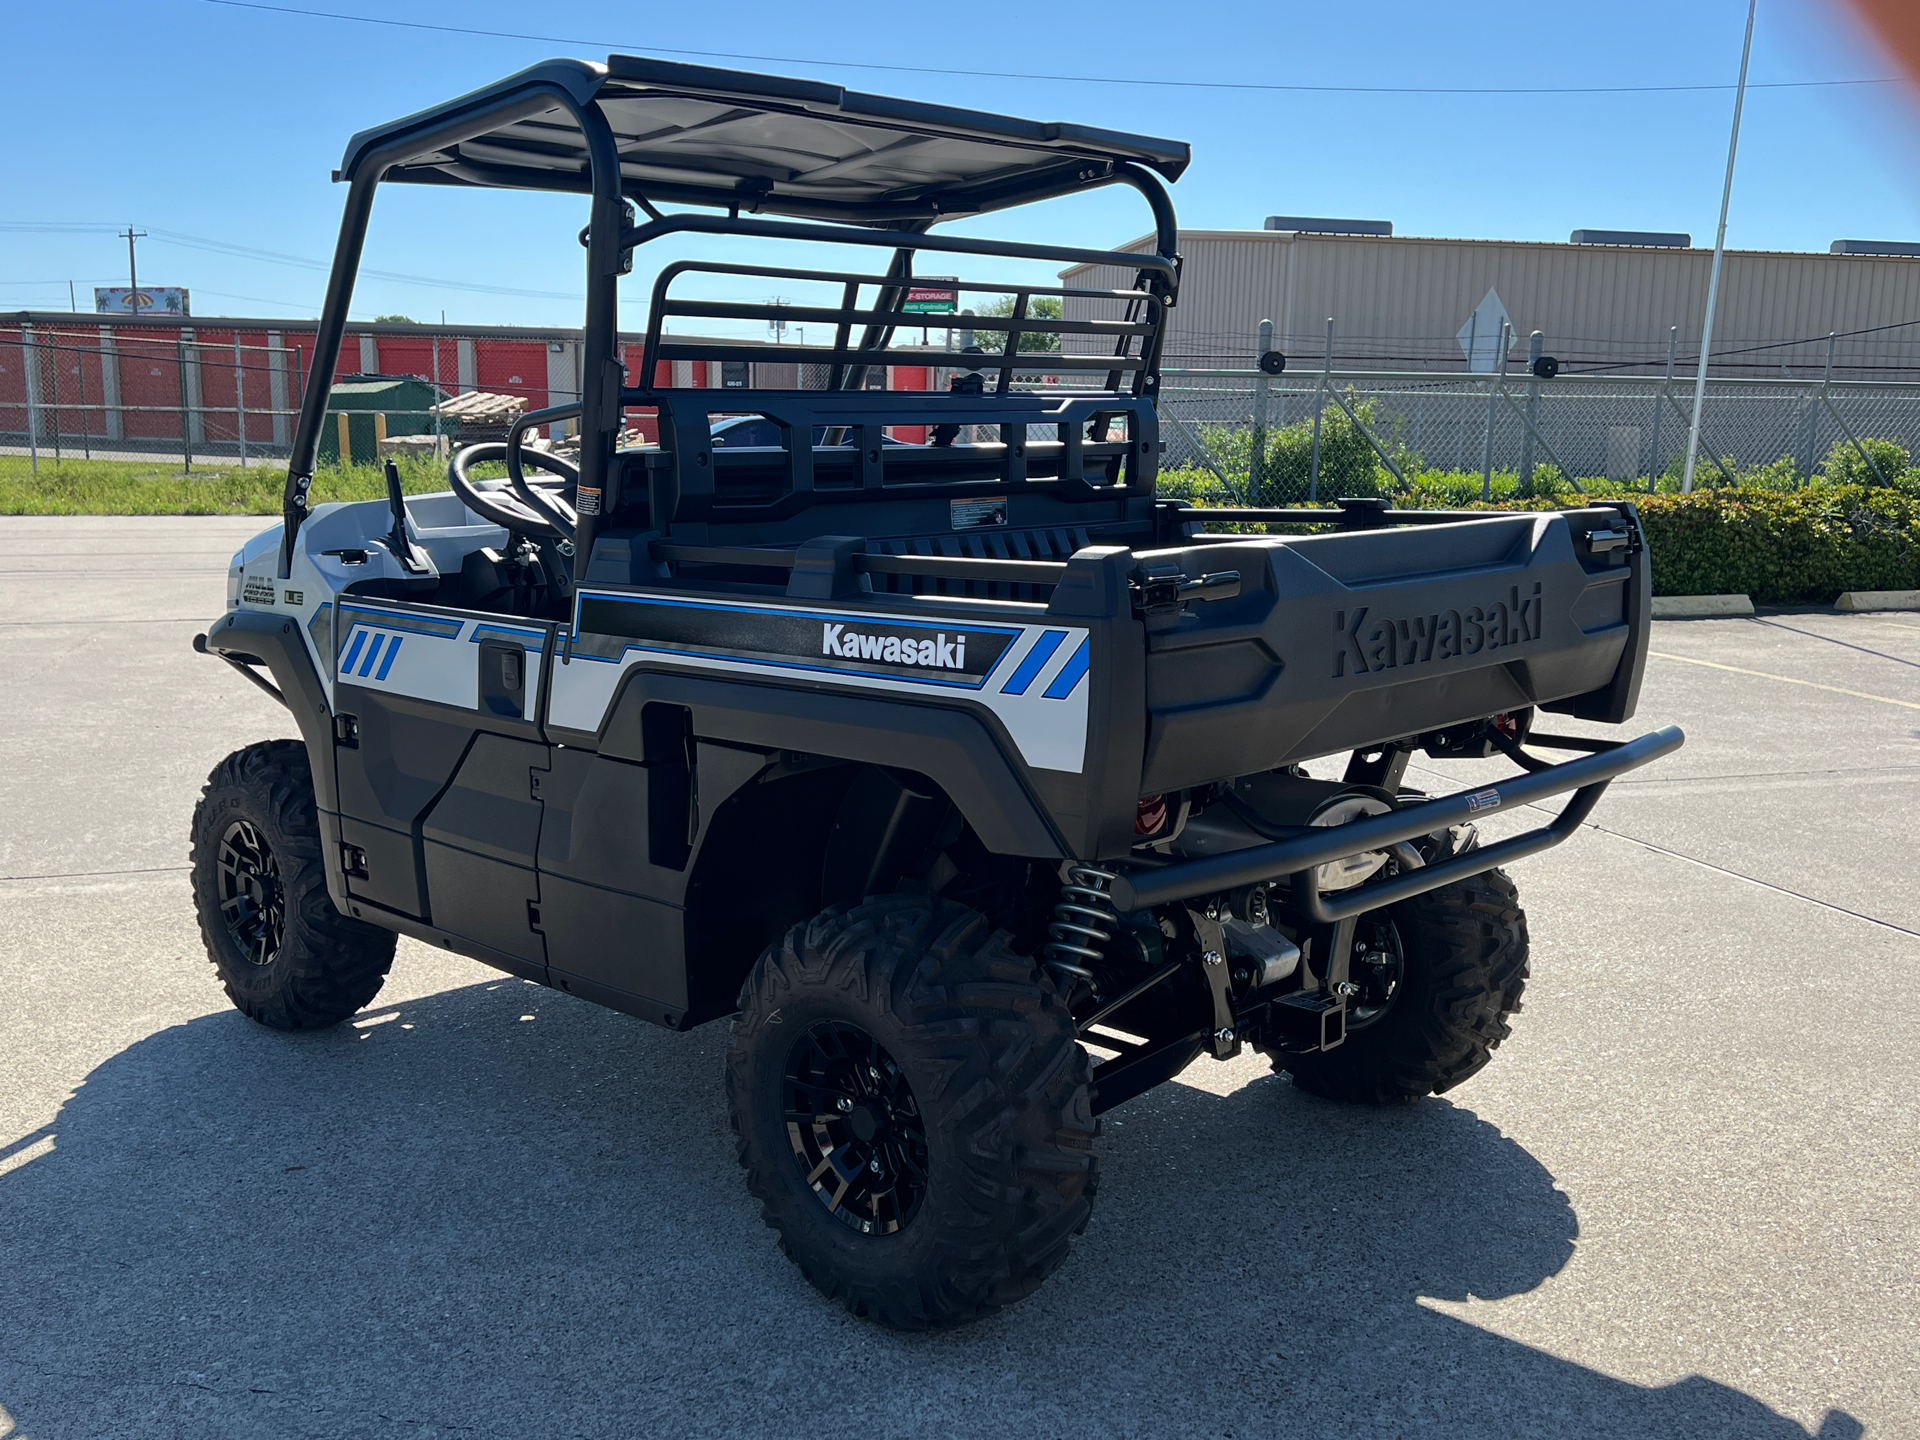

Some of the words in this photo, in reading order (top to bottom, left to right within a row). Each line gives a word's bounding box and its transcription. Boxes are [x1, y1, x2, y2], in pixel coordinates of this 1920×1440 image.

[245, 575, 274, 591] MULE
[246, 596, 272, 605] 1000
[285, 591, 303, 604] LE
[1331, 581, 1542, 678] Kawasaki
[822, 622, 966, 669] Kawasaki
